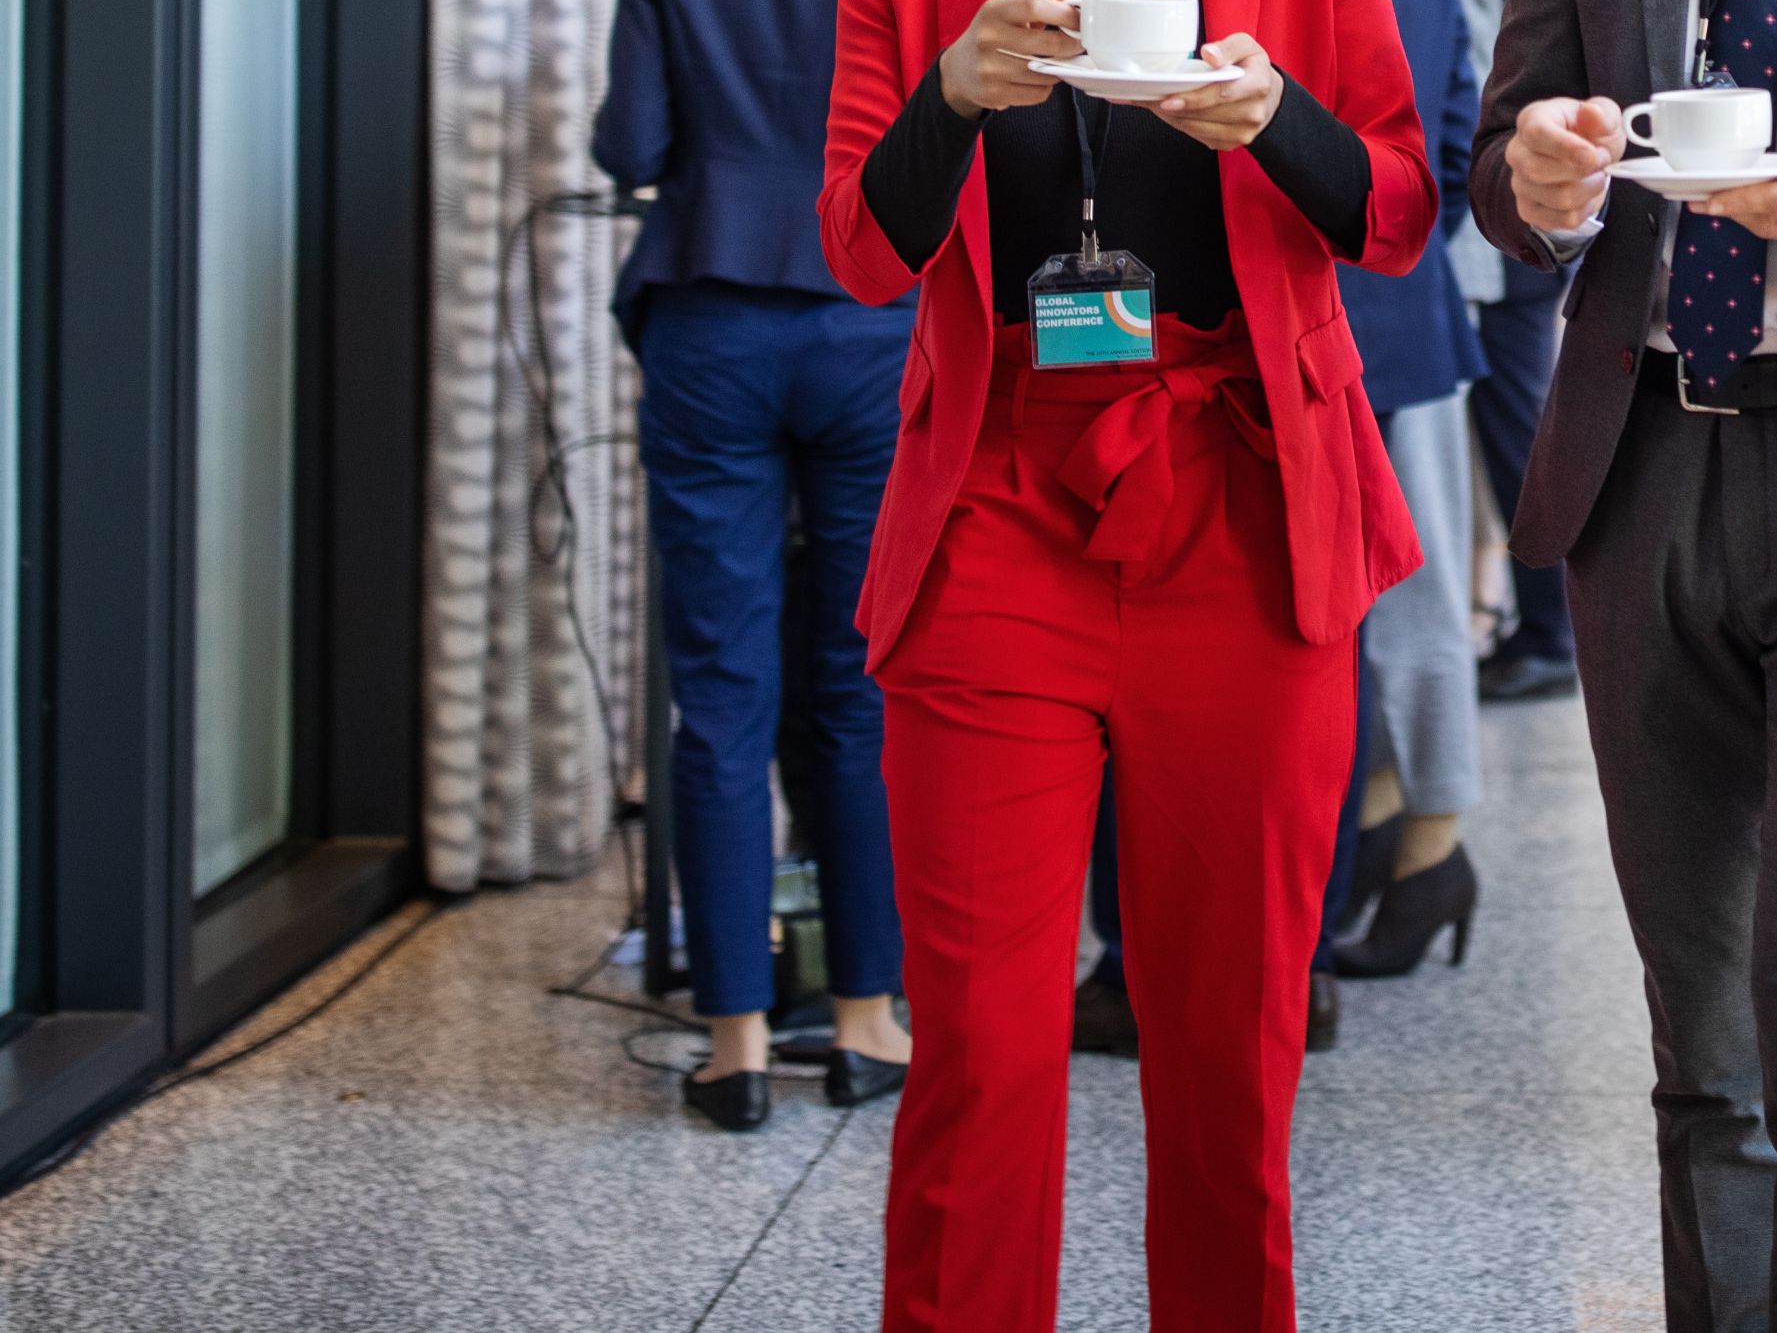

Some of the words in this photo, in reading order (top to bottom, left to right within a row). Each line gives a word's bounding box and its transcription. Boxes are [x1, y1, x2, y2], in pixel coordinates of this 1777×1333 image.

[1035, 297, 1075, 307] GLOBAL
[1036, 306, 1100, 317] INNOVATORS
[1036, 317, 1104, 328] CONFERENCE
